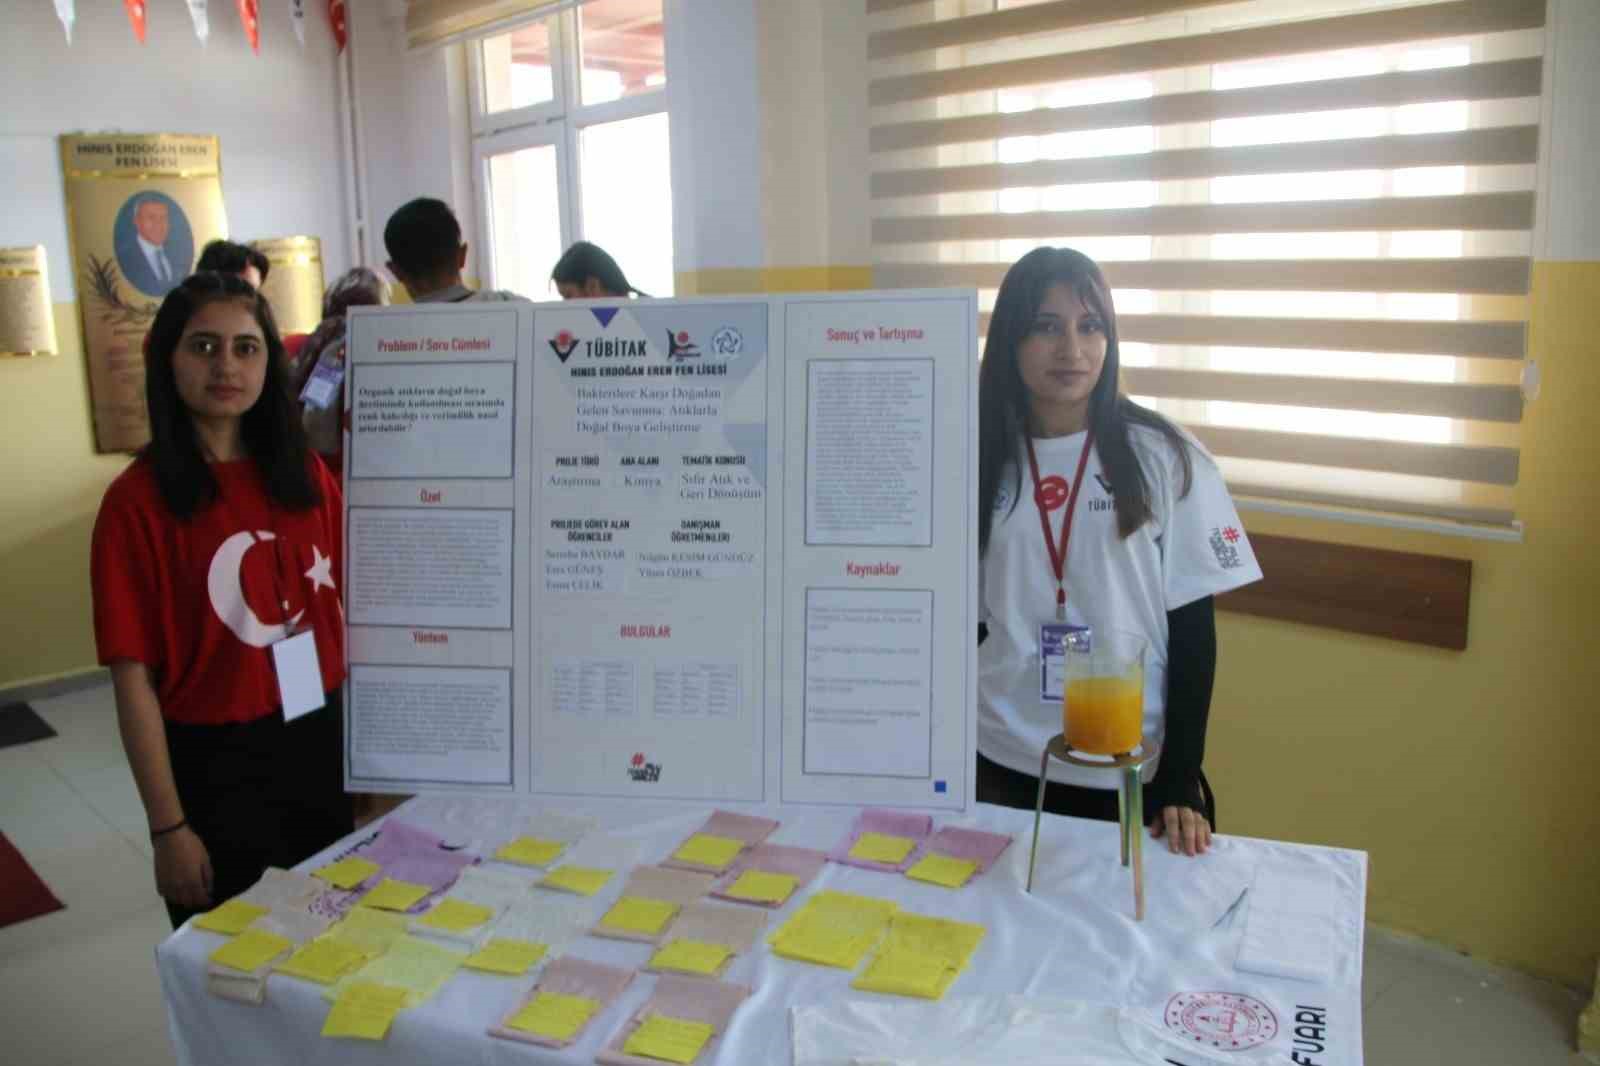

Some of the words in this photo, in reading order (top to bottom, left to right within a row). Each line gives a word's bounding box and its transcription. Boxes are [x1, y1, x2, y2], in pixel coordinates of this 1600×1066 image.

[827, 328, 859, 344] Sonuç
[863, 329, 876, 341] ve
[878, 327, 924, 343] Tartışma
[377, 338, 417, 352] Problem
[426, 338, 449, 352] Soru
[452, 337, 491, 351] Cümlesi
[586, 340, 647, 358] TÜBİTAK
[571, 366, 597, 377] HINIS
[599, 365, 645, 377] ERDOĞAN
[647, 366, 673, 376] EREN
[675, 365, 694, 376] FEN
[696, 363, 728, 376] LİSESİ
[576, 421, 609, 434] Doğal
[612, 421, 641, 435] Boya
[420, 488, 441, 503] Özel
[611, 520, 630, 530] ALAN
[847, 560, 902, 578] Kaynaklar
[620, 625, 671, 638] BULGULAR
